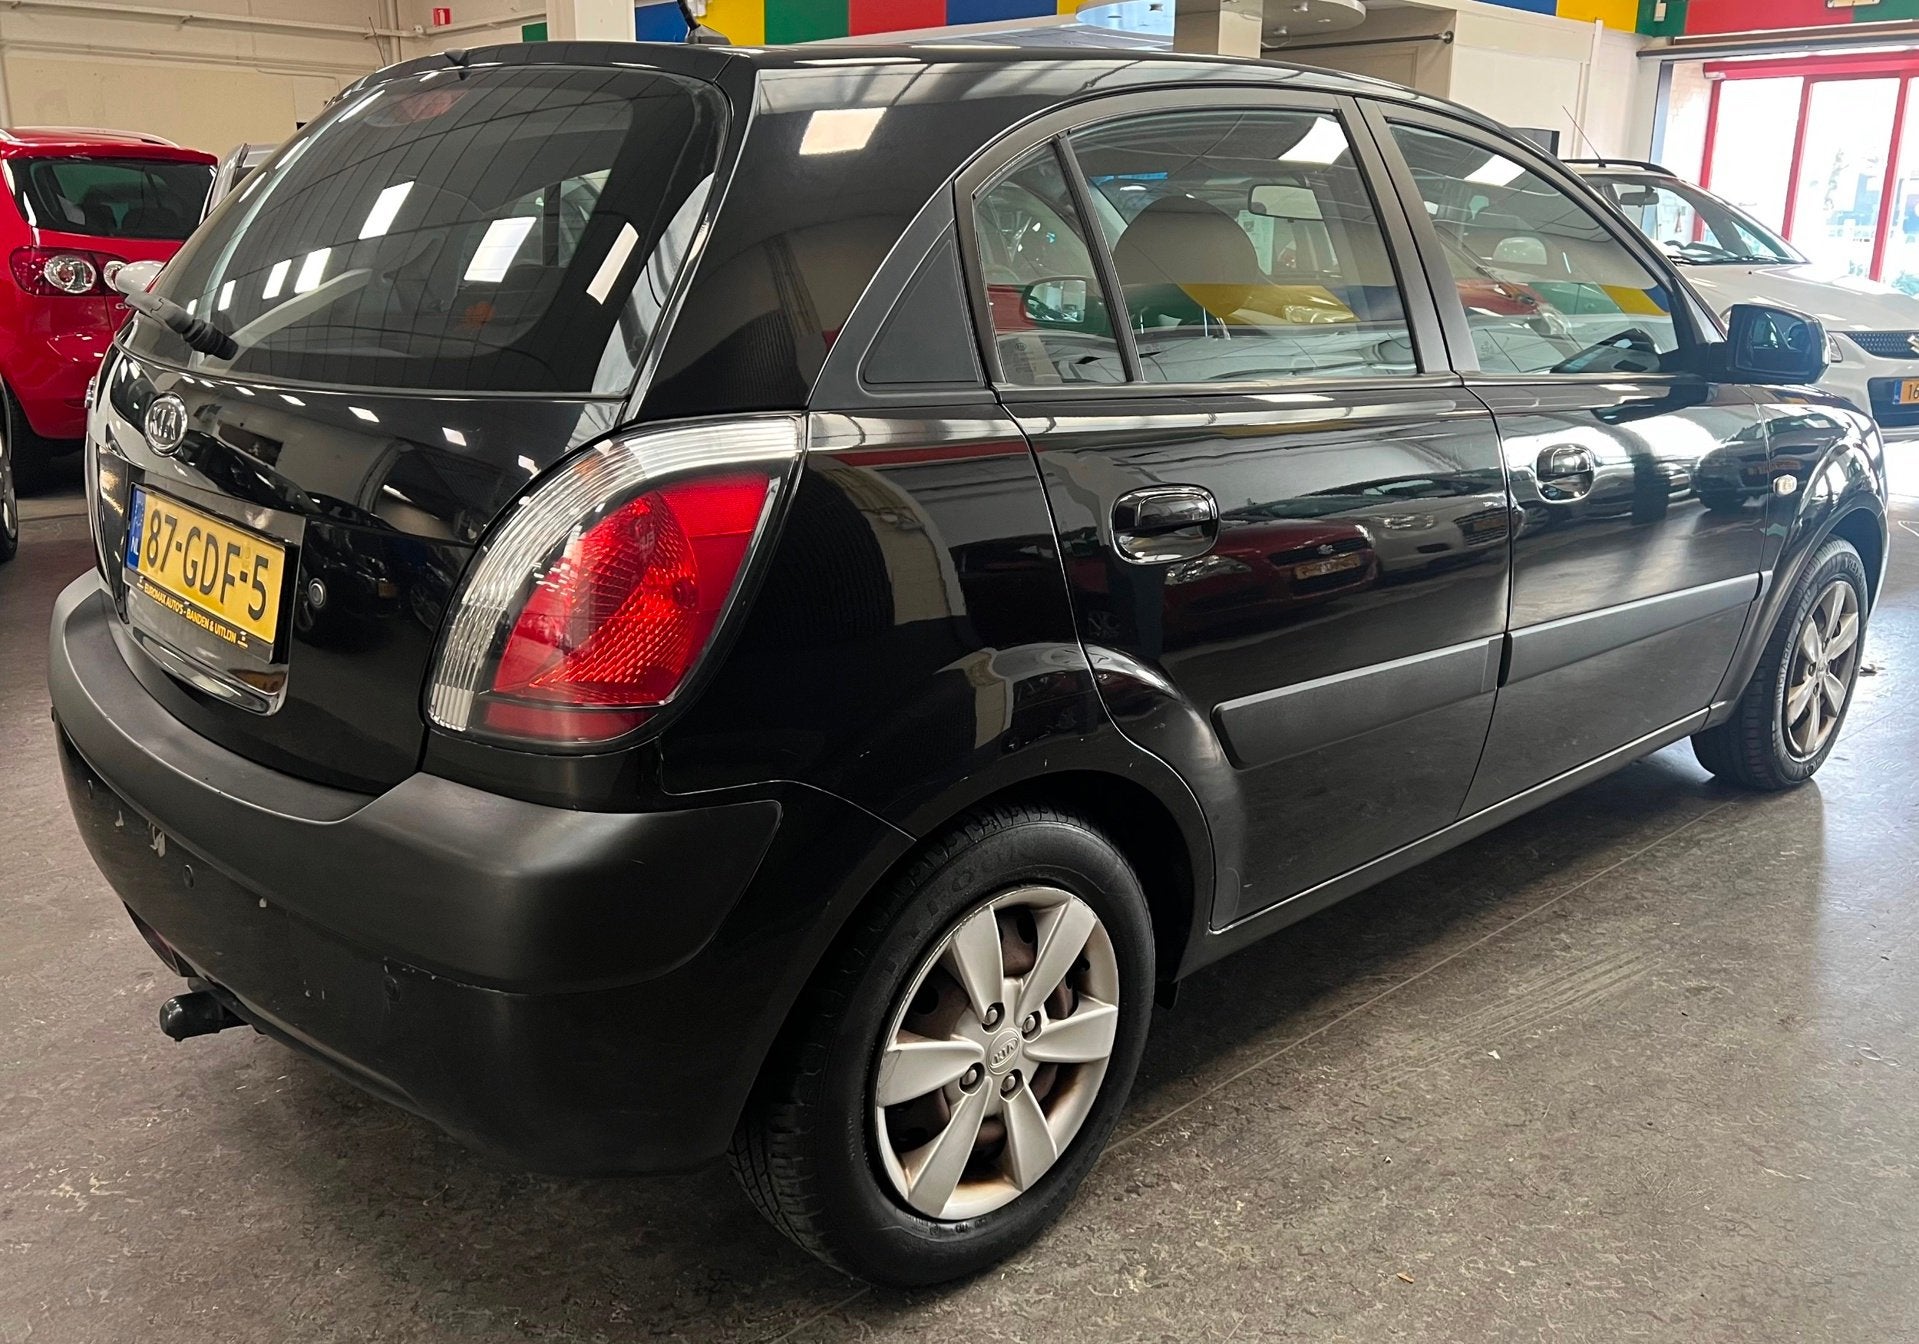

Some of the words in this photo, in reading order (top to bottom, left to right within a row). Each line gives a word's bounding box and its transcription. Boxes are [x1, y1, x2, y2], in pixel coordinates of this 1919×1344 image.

[149, 405, 177, 441] KIA
[130, 536, 139, 556] NL
[146, 508, 269, 621] 87-GDF-5
[186, 609, 210, 630] BANDEN
[992, 1042, 1017, 1065] KIA
